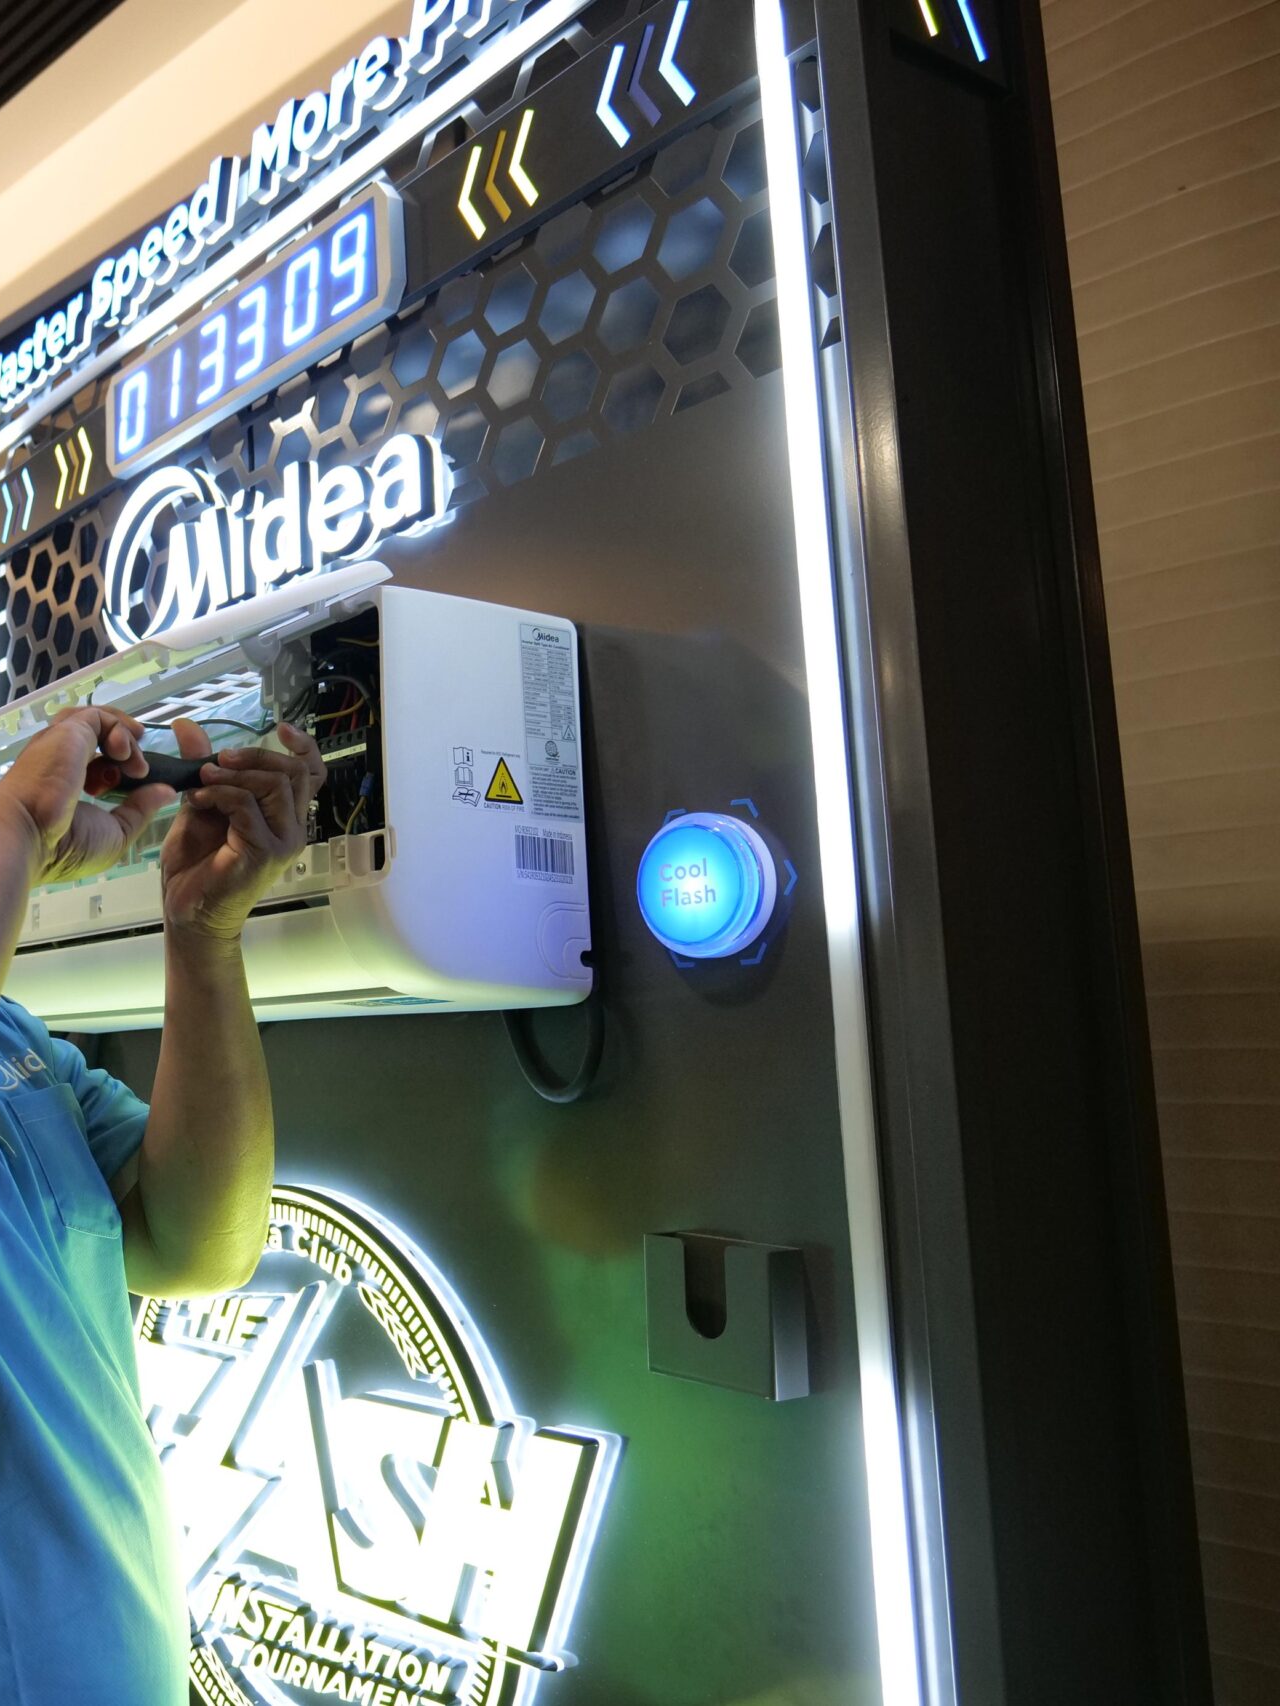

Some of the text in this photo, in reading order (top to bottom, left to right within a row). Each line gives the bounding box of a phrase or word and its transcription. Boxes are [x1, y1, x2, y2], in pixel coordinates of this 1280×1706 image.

[90, 155, 224, 320] Speed
[247, 35, 391, 199] More
[102, 433, 426, 652] Midea
[532, 628, 560, 643] Midea
[659, 857, 708, 882] Cool
[661, 884, 717, 908] Flash
[292, 1229, 353, 1287] Club
[187, 1295, 277, 1349] THE
[190, 1580, 453, 1697] INSTALLATION
[220, 1633, 458, 1706] TOURNAMEN
